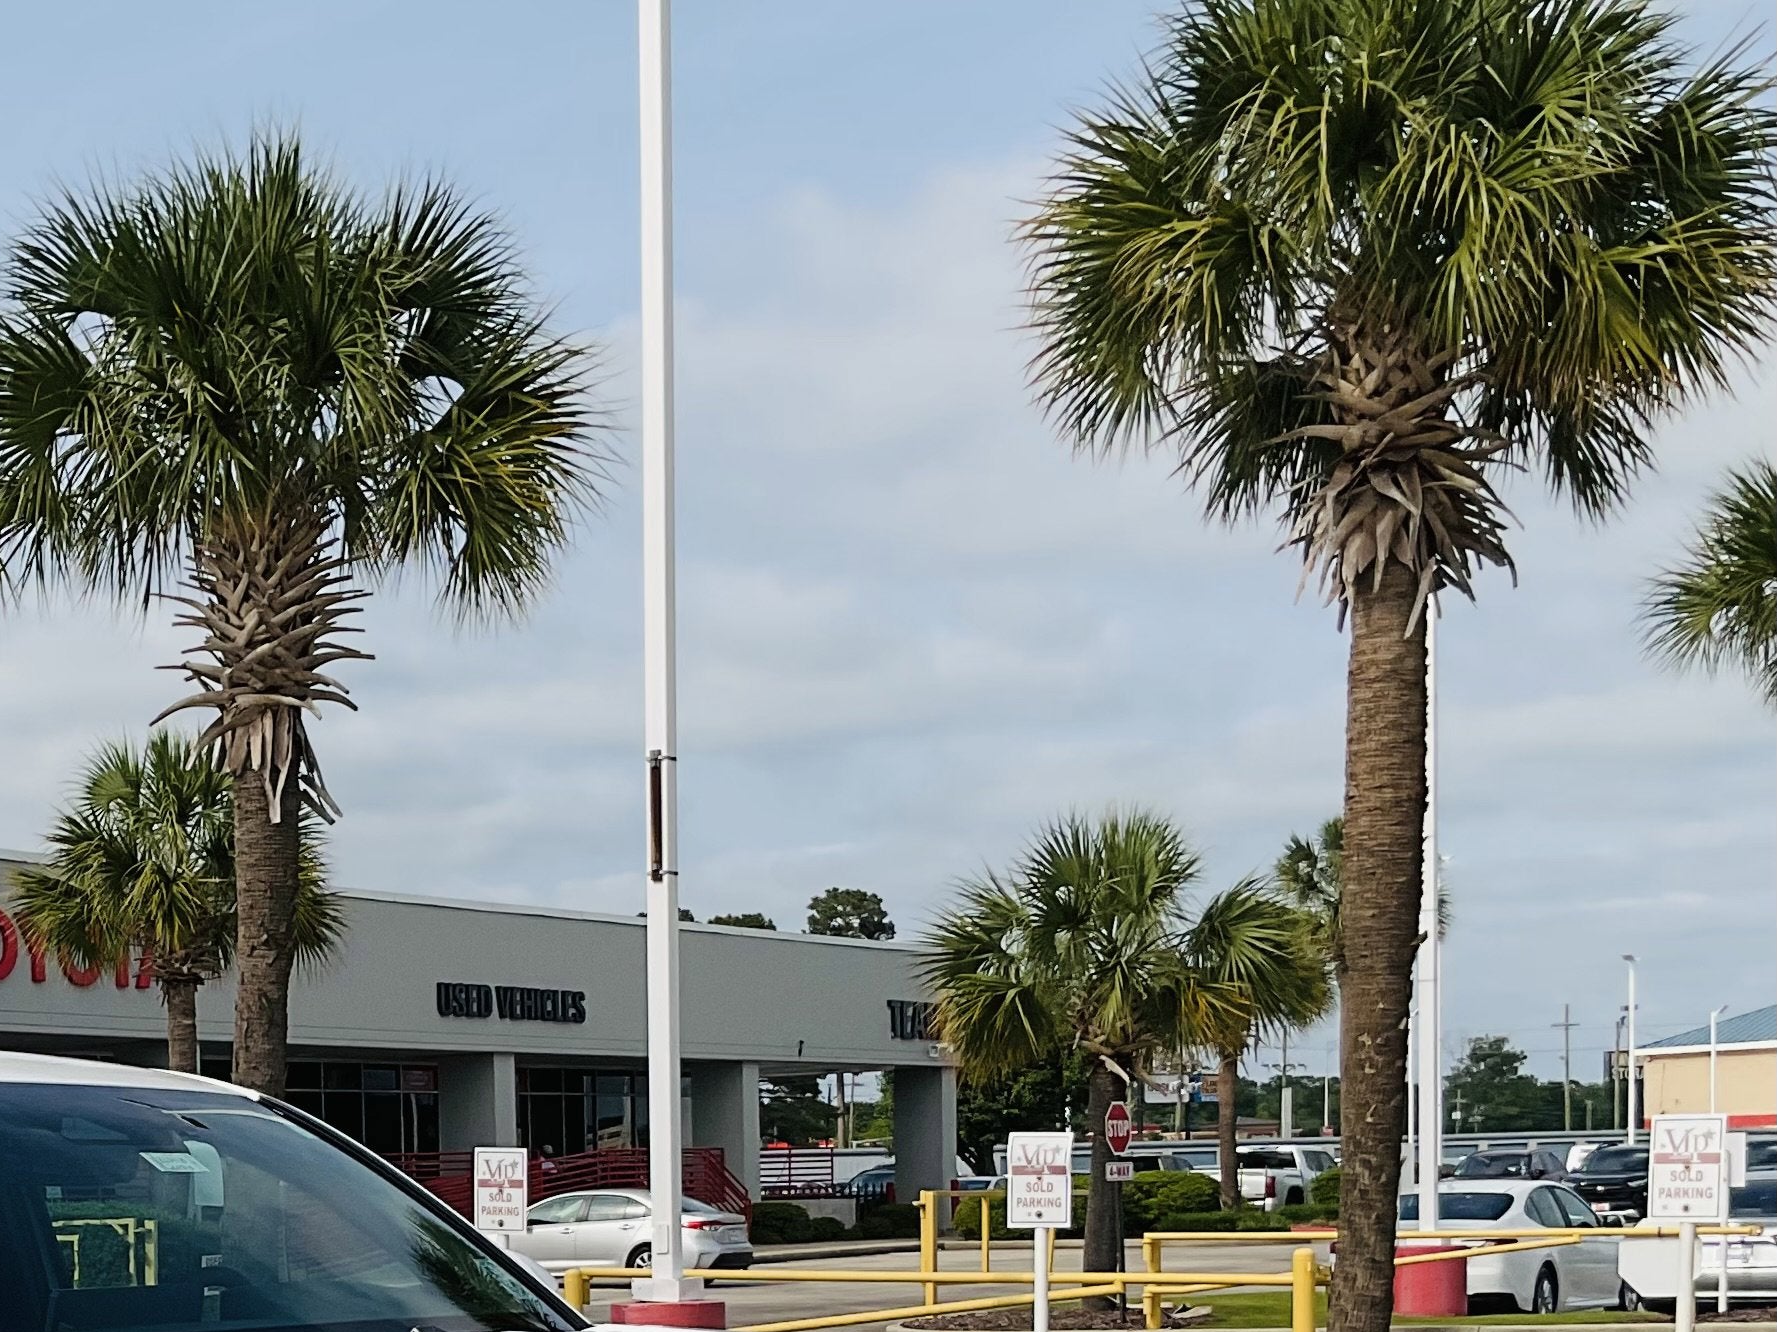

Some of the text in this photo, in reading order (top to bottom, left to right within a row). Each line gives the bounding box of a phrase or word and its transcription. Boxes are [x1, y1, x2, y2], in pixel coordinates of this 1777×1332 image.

[436, 982, 586, 1023] USED VEHICLES
[1107, 1120, 1130, 1138] STOP
[1109, 1165, 1130, 1177] 4-WAY
[1670, 1170, 1703, 1182] SOLD
[1026, 1182, 1054, 1193] SOLD
[1658, 1187, 1713, 1199] PARKING
[489, 1193, 512, 1202] SOLD
[1016, 1197, 1062, 1208] PARKING
[481, 1206, 520, 1216] PARKING
